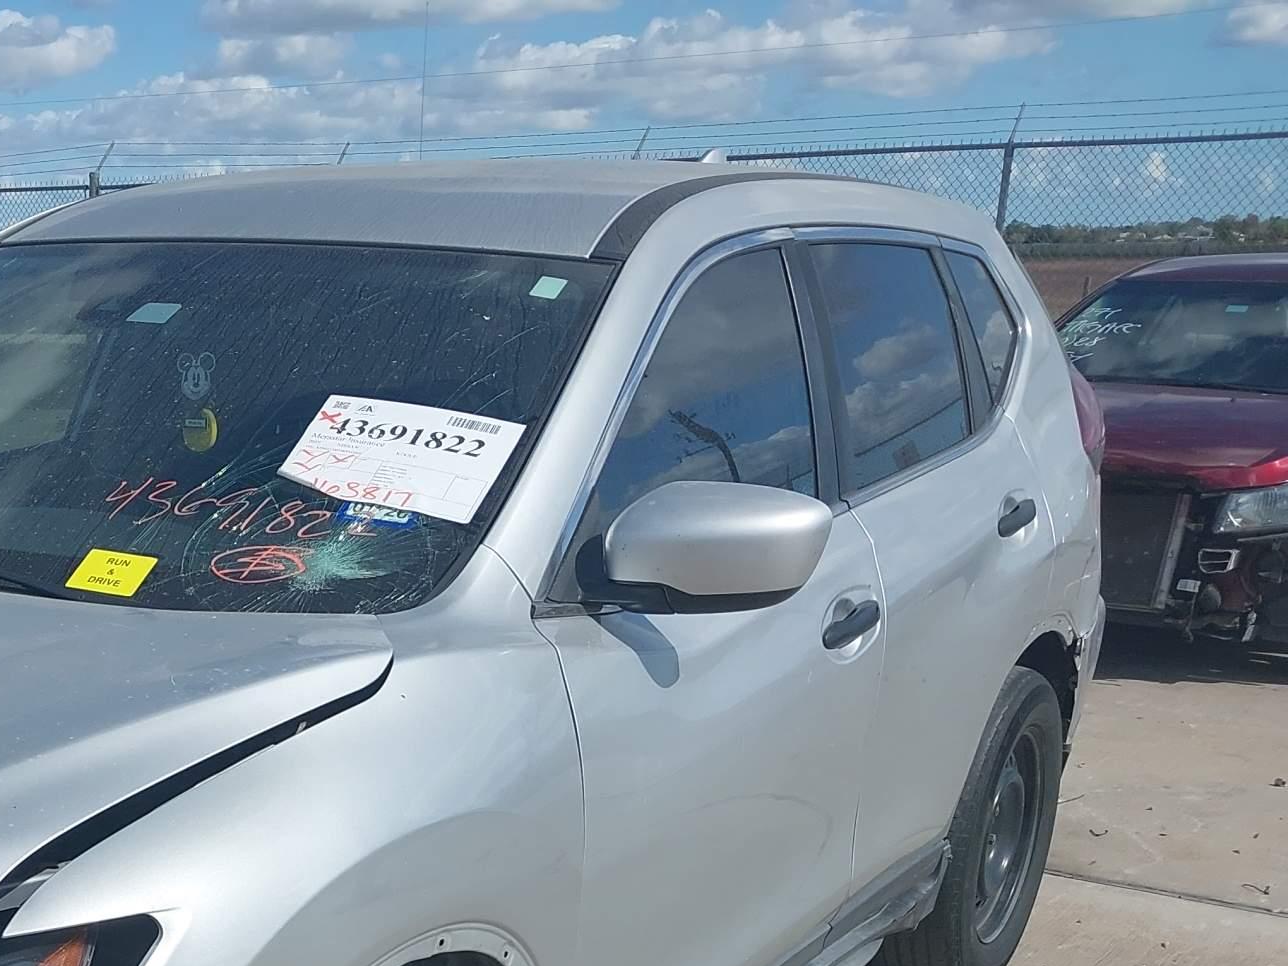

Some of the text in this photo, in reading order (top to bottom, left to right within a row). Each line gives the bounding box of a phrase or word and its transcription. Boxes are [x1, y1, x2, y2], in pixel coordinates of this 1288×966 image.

[329, 417, 487, 458] 43691822
[106, 557, 131, 567] RUN
[106, 568, 115, 576] &
[87, 575, 122, 588] DRIVE
